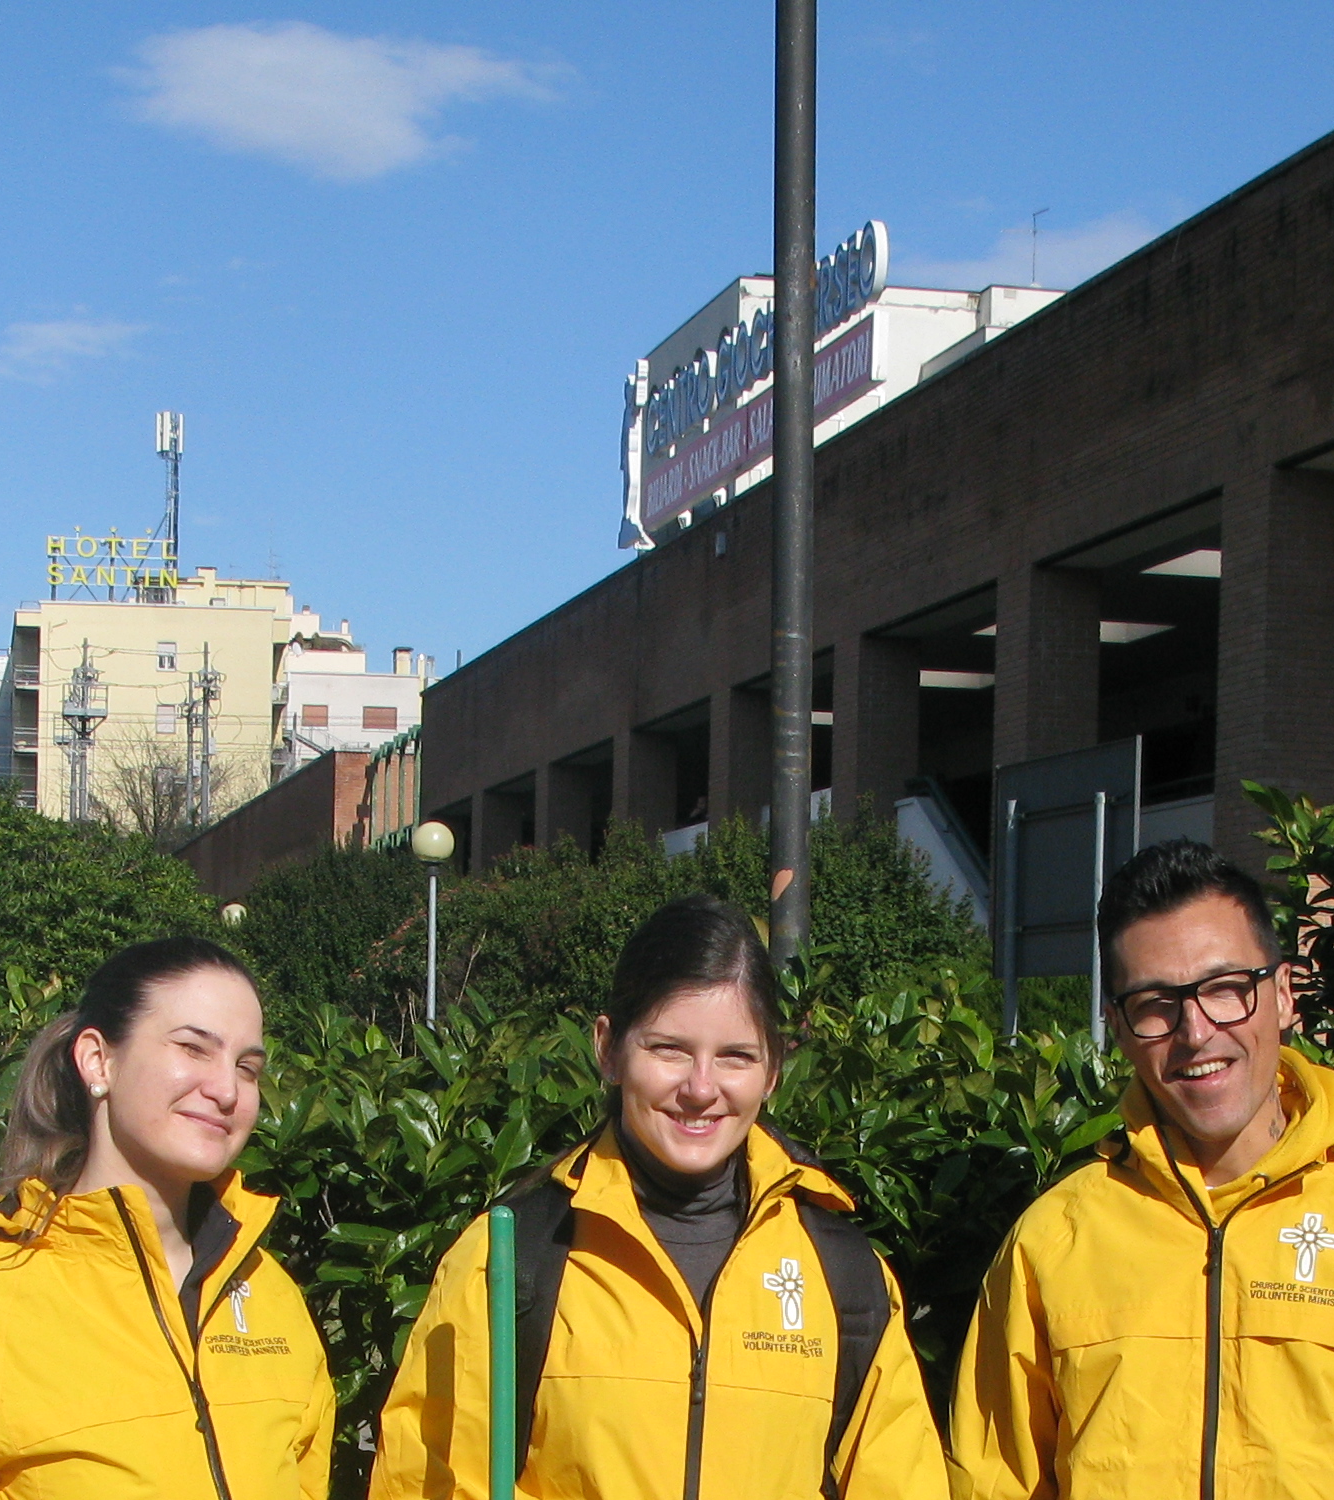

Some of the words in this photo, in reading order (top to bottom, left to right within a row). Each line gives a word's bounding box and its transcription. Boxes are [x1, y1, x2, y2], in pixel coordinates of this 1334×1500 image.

[813, 331, 873, 407] UMATORI
[645, 347, 712, 455] CENTRO
[46, 534, 178, 560] HOTEL
[46, 564, 178, 588] SANTIN
[1250, 1280, 1285, 1291] CHURCH
[1286, 1283, 1297, 1291] OF
[1250, 1290, 1305, 1303] VOLUNTEER
[742, 1331, 774, 1342] CHURCH
[777, 1334, 788, 1342] OF
[742, 1341, 798, 1354] VOLUNTEER
